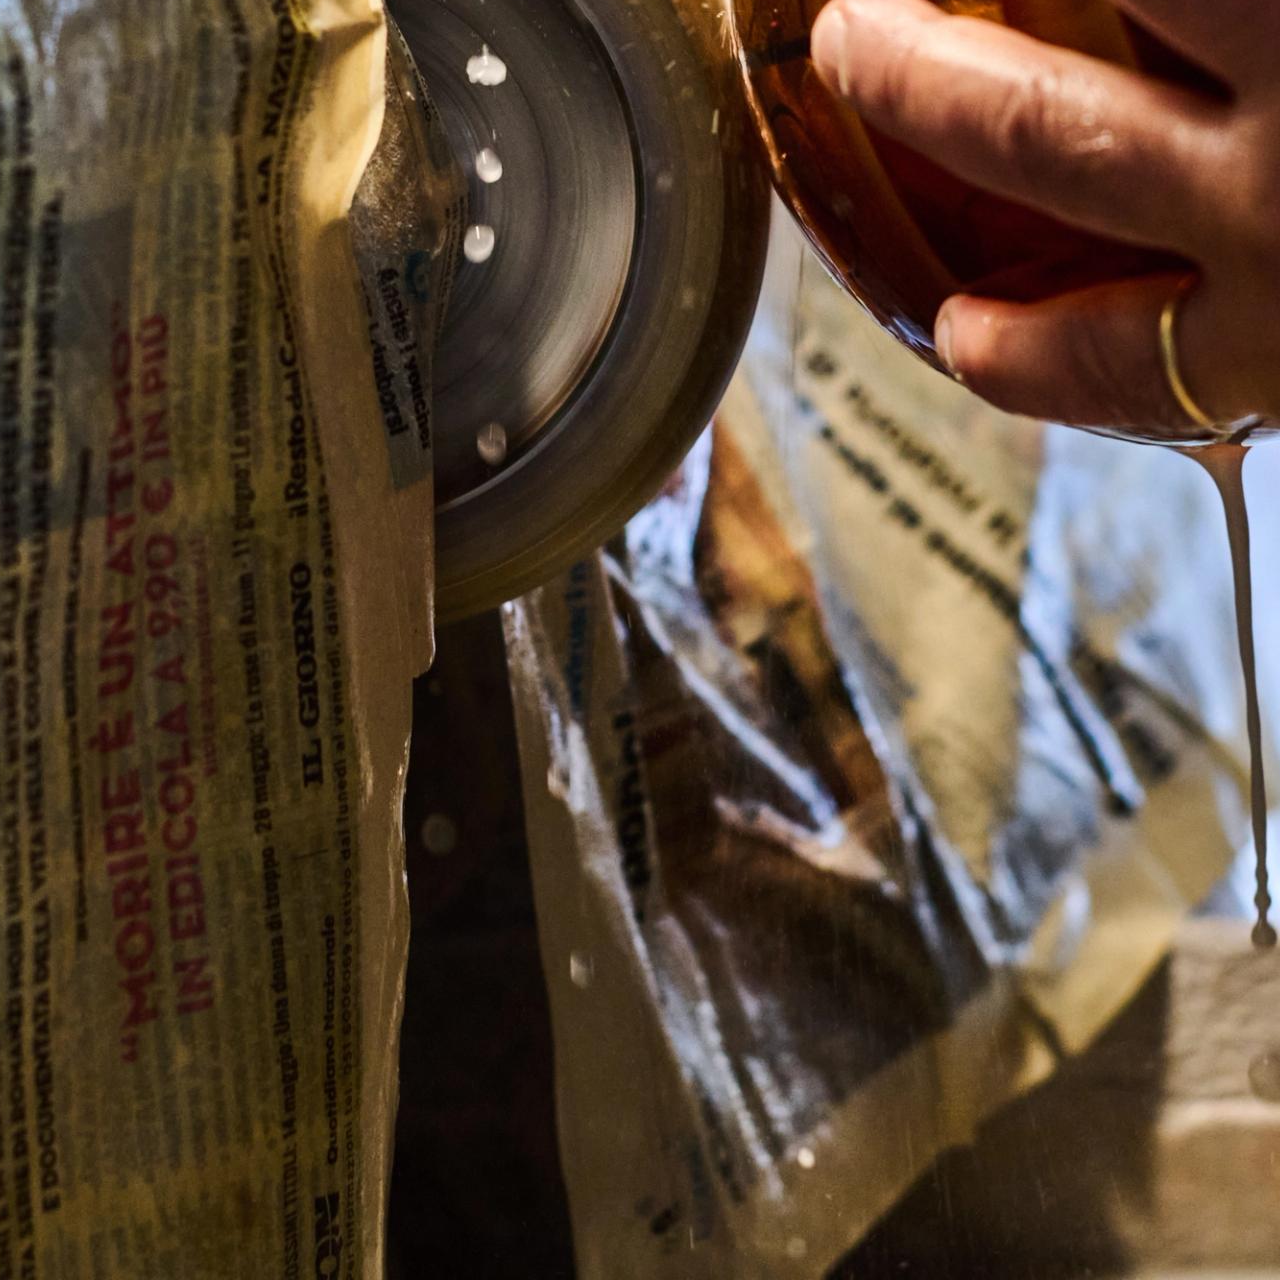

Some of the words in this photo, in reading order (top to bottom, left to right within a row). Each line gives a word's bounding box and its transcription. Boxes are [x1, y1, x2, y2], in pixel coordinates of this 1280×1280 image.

[134, 313, 169, 396] PIÙ
[404, 355, 432, 451] voucher
[141, 409, 170, 464] IN
[282, 414, 309, 503] Resto
[139, 478, 173, 514] €
[143, 534, 187, 639] 9,90
[236, 571, 259, 627] Axum
[96, 601, 136, 700] UN
[150, 654, 188, 684] A
[236, 630, 258, 649] di
[288, 562, 320, 730] GIORNO
[241, 652, 262, 698] rose
[85, 710, 136, 754] È
[244, 702, 264, 726] Le
[329, 734, 347, 753] al
[246, 728, 272, 804] maggio:
[301, 737, 324, 788] IL
[329, 759, 351, 822] lunedì
[154, 702, 207, 941] EDICOLA
[252, 807, 273, 835] 28
[333, 829, 353, 861] dal
[28, 827, 47, 892] VITA
[260, 845, 282, 909] troppo
[28, 897, 51, 985] DELLA
[265, 913, 284, 930] di
[173, 956, 215, 1016] IN
[268, 934, 290, 994] donna
[319, 914, 338, 1032] Nazionale
[272, 997, 293, 1035] Una
[4, 996, 27, 1126] ROMANZI
[30, 990, 59, 1192] DOCUMENTATA
[276, 1039, 300, 1113] maggio:
[280, 1118, 297, 1139] 14
[323, 1035, 339, 1166] Quotidiano
[40, 1195, 61, 1213] E
